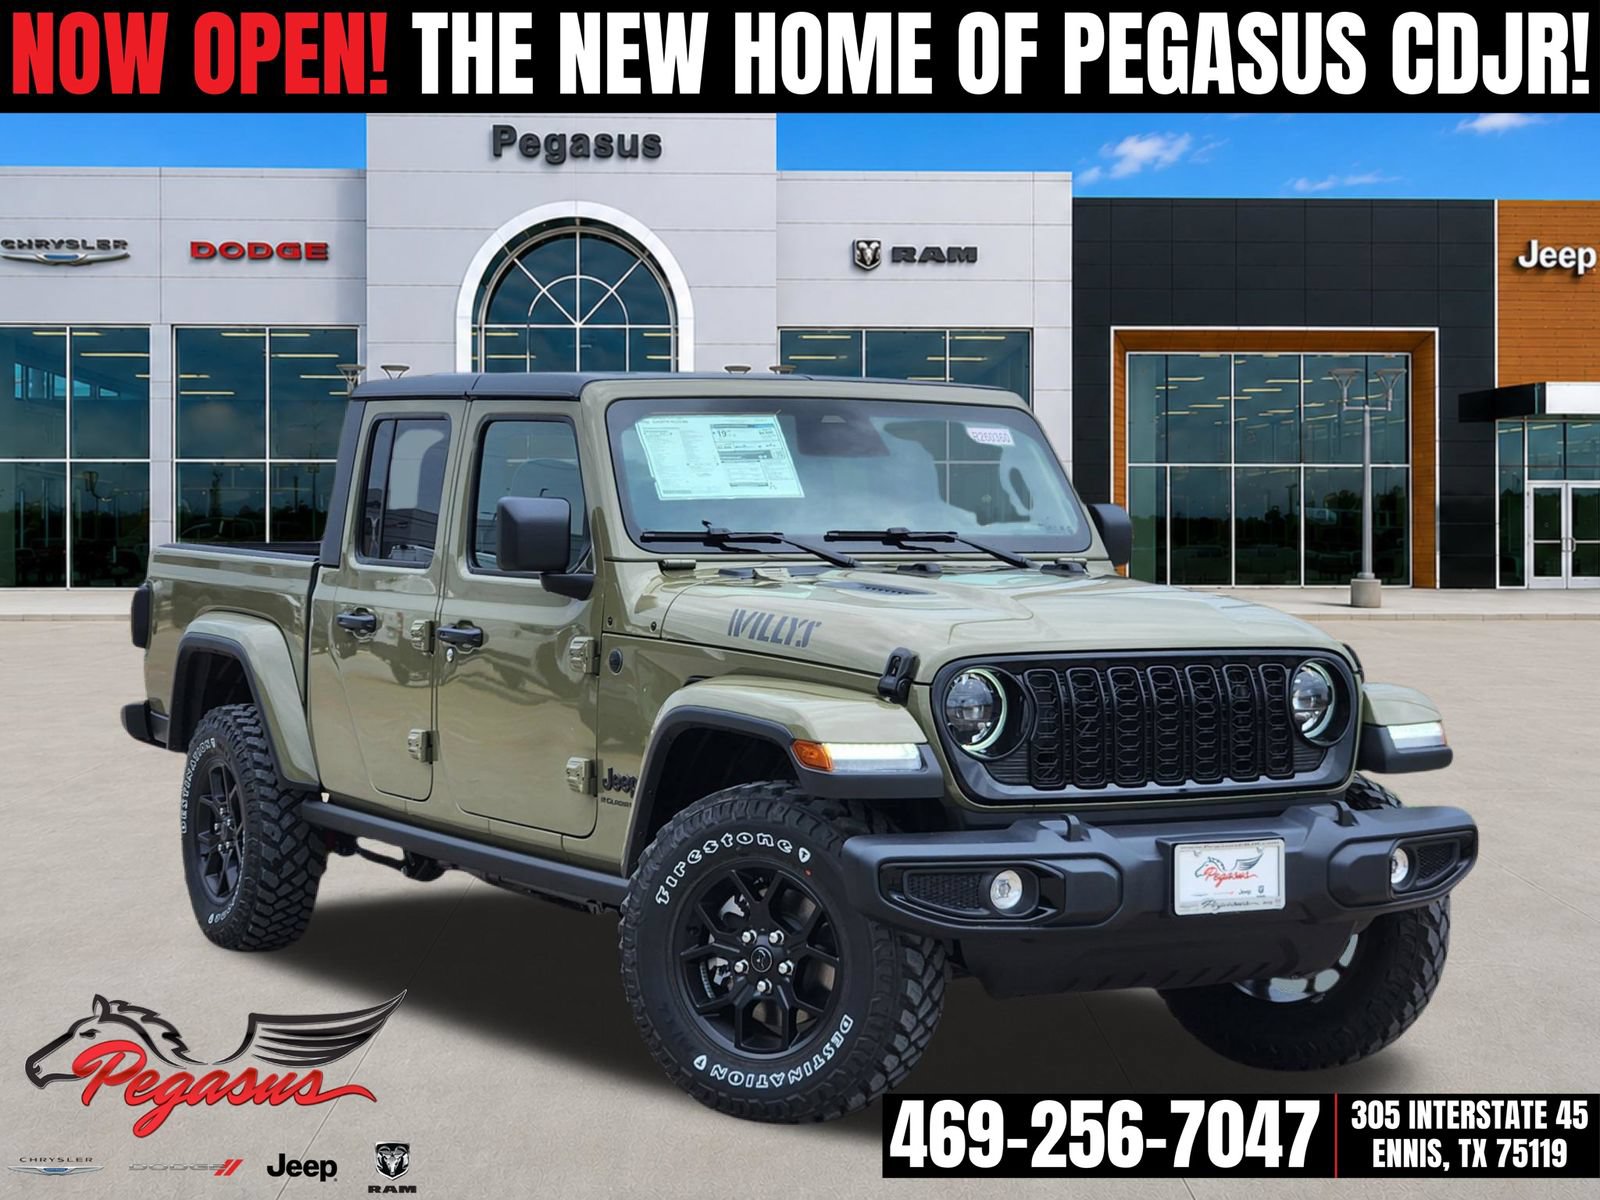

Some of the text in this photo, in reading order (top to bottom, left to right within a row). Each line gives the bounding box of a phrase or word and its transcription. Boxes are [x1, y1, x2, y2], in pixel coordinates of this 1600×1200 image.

[492, 124, 662, 166] Pegasus
[0, 239, 128, 250] CHRYSLER
[190, 241, 329, 260] DODGE
[892, 246, 978, 264] RAM
[1518, 239, 1597, 275] Jeep
[728, 608, 822, 648] WILLYS
[655, 831, 793, 906] Firestone
[1203, 865, 1258, 888] Pegasus
[710, 1014, 854, 1089] DESTINATION
